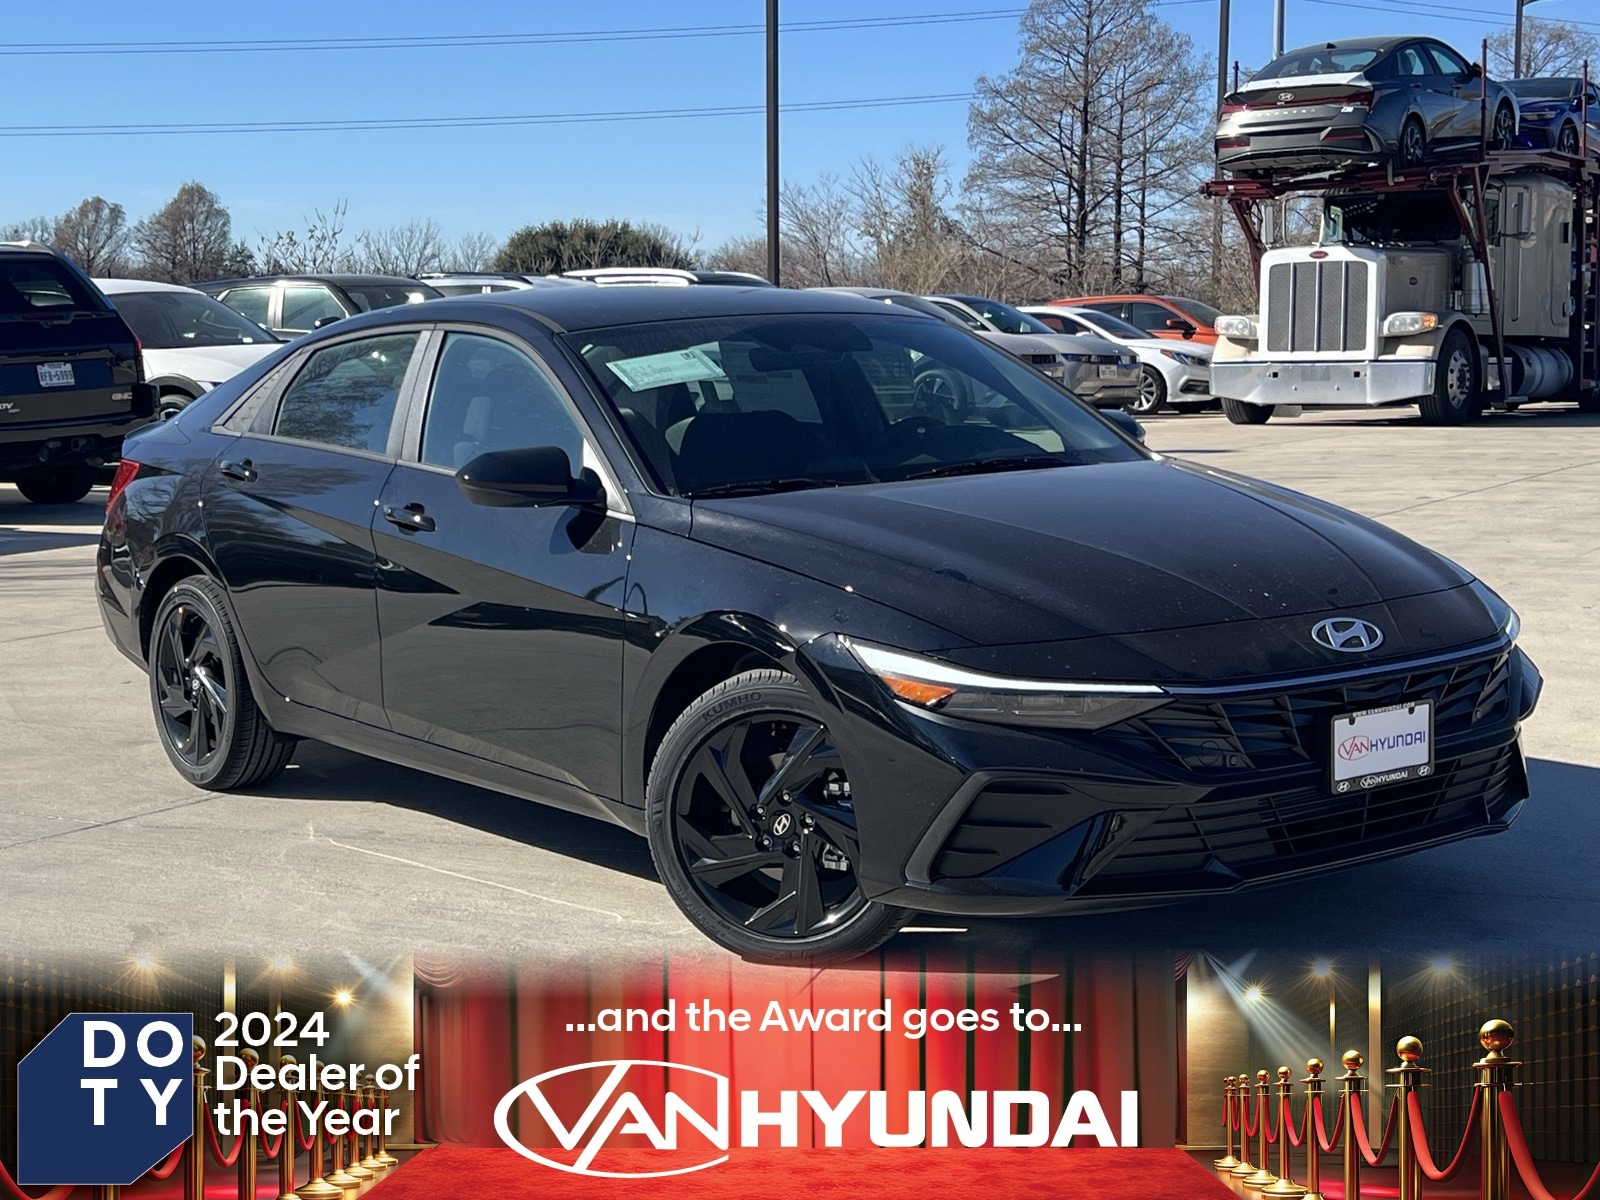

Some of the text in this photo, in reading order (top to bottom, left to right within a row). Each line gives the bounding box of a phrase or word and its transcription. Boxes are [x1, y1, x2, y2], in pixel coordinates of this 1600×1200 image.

[702, 692, 764, 721] KUMHO
[1340, 730, 1426, 760] VAN HYUNDAI
[1375, 770, 1408, 783] HYUNDAI
